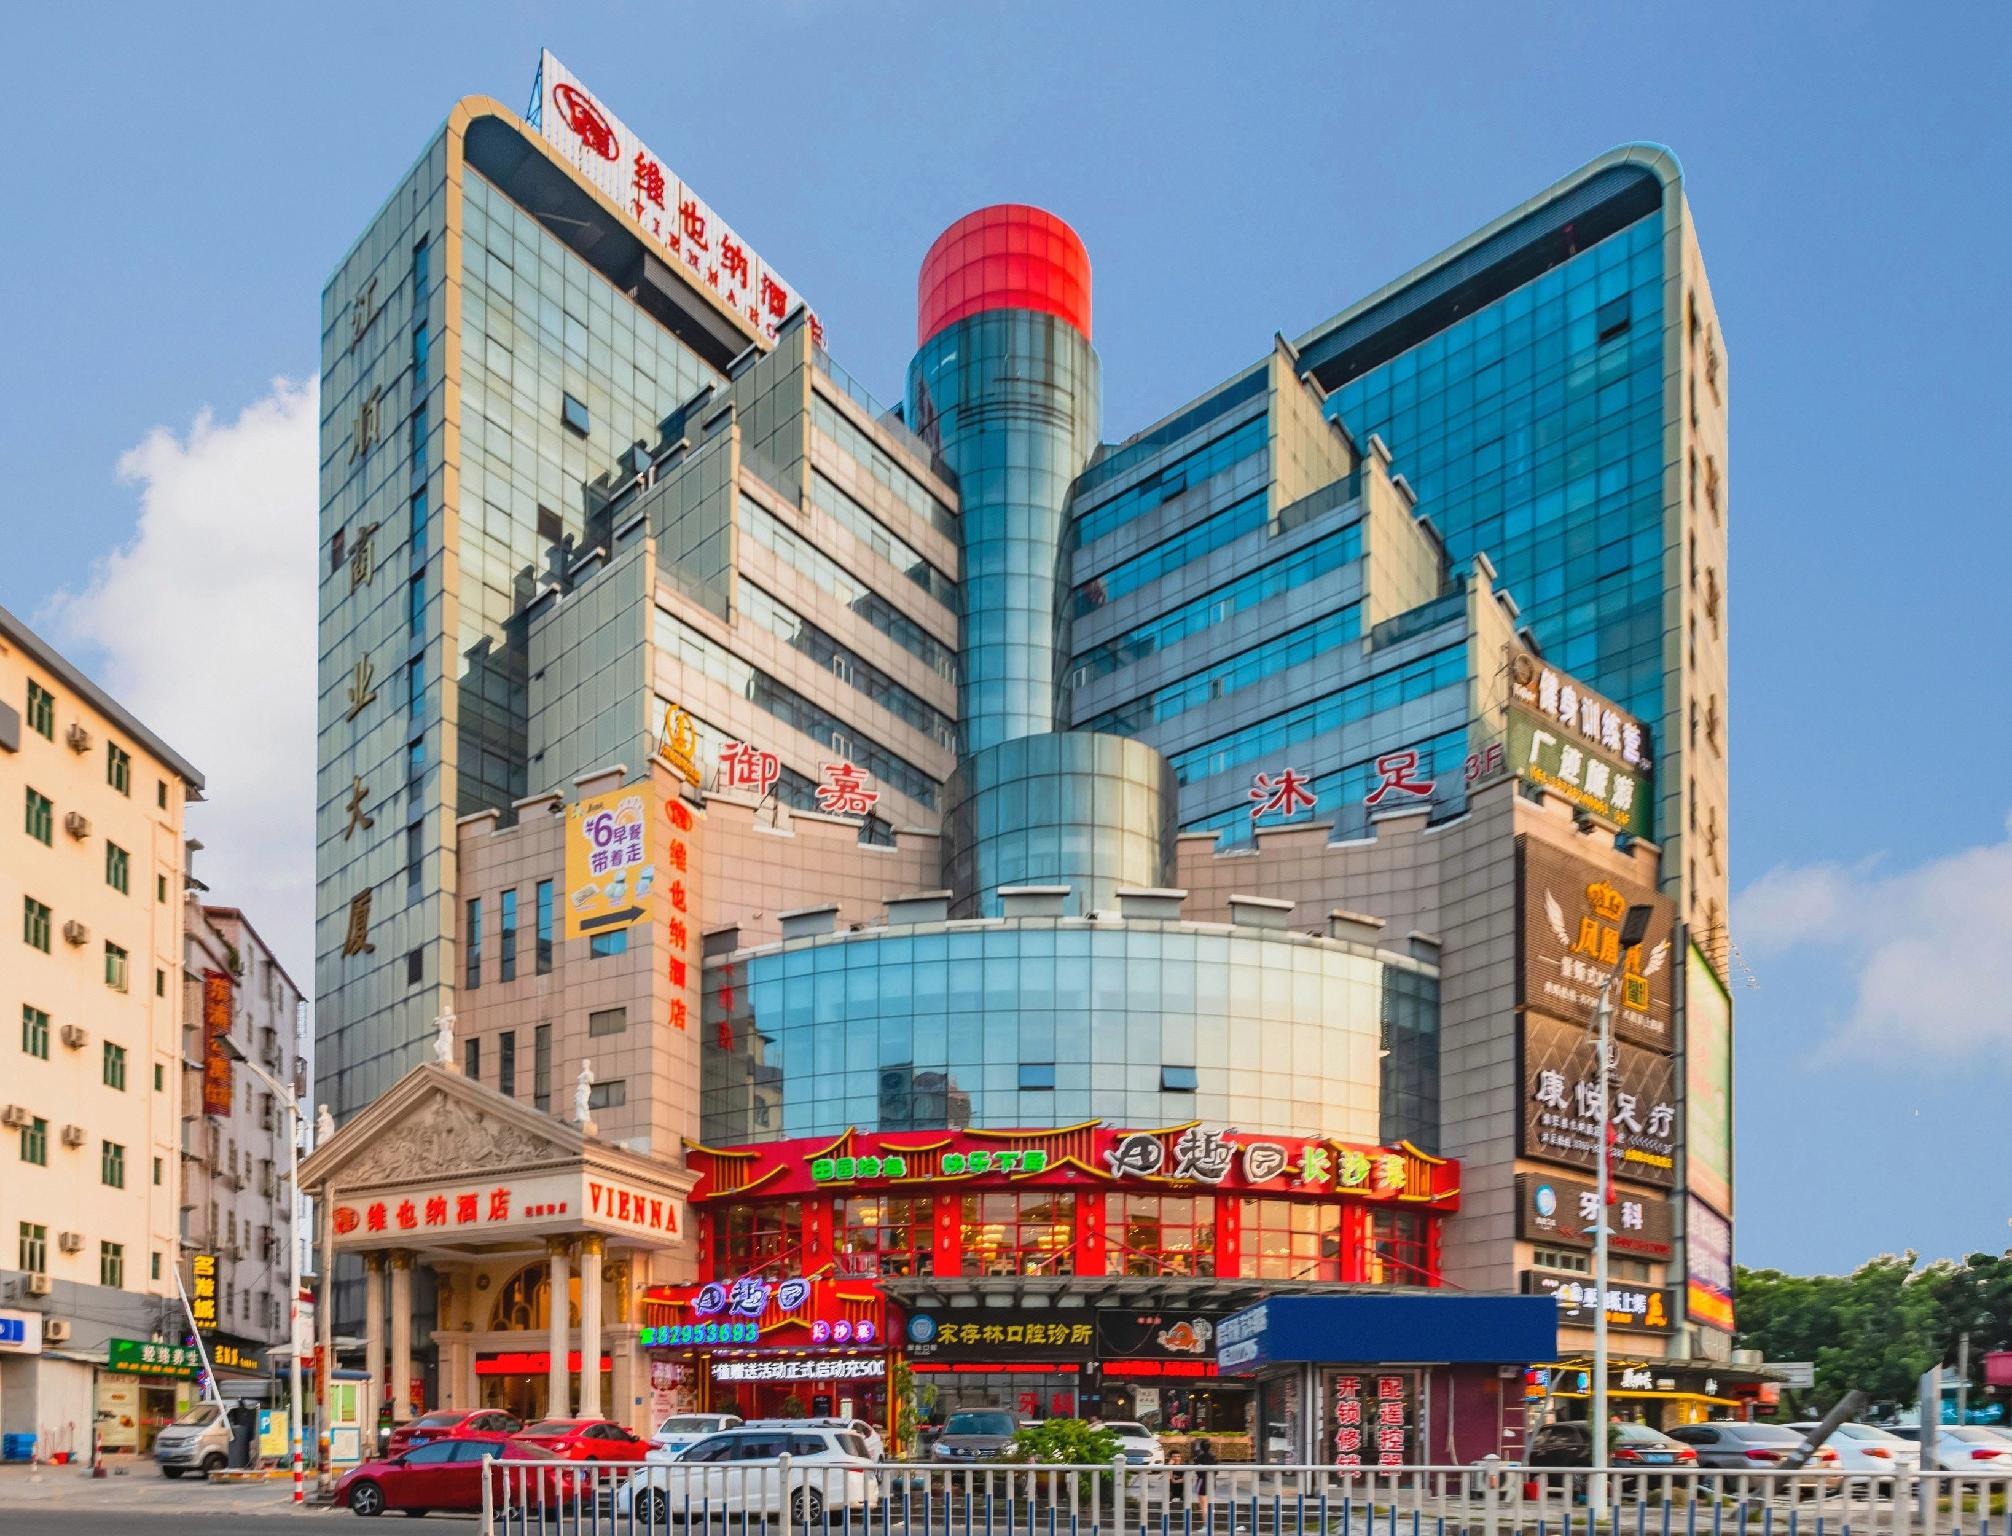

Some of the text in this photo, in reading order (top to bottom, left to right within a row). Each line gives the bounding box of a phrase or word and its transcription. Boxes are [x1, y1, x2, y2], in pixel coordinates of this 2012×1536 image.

[341, 276, 382, 958] 江顺商业大厦
[719, 741, 880, 815] 御嘉
[1248, 750, 1436, 818] 沐足
[1465, 742, 1504, 782] 3F
[592, 844, 643, 873] 带着走
[667, 837, 689, 1032] 维也纳酒店
[1534, 1069, 1676, 1137] 康悦足疗
[1300, 1145, 1408, 1189] 长沙菜
[365, 1186, 514, 1233] 维也纳酒店
[589, 1181, 679, 1233] VIENNA
[1578, 1190, 1644, 1231] 牙科
[812, 1319, 877, 1344] 长沙菜
[937, 1321, 1094, 1346] 宋存林口腔诊所
